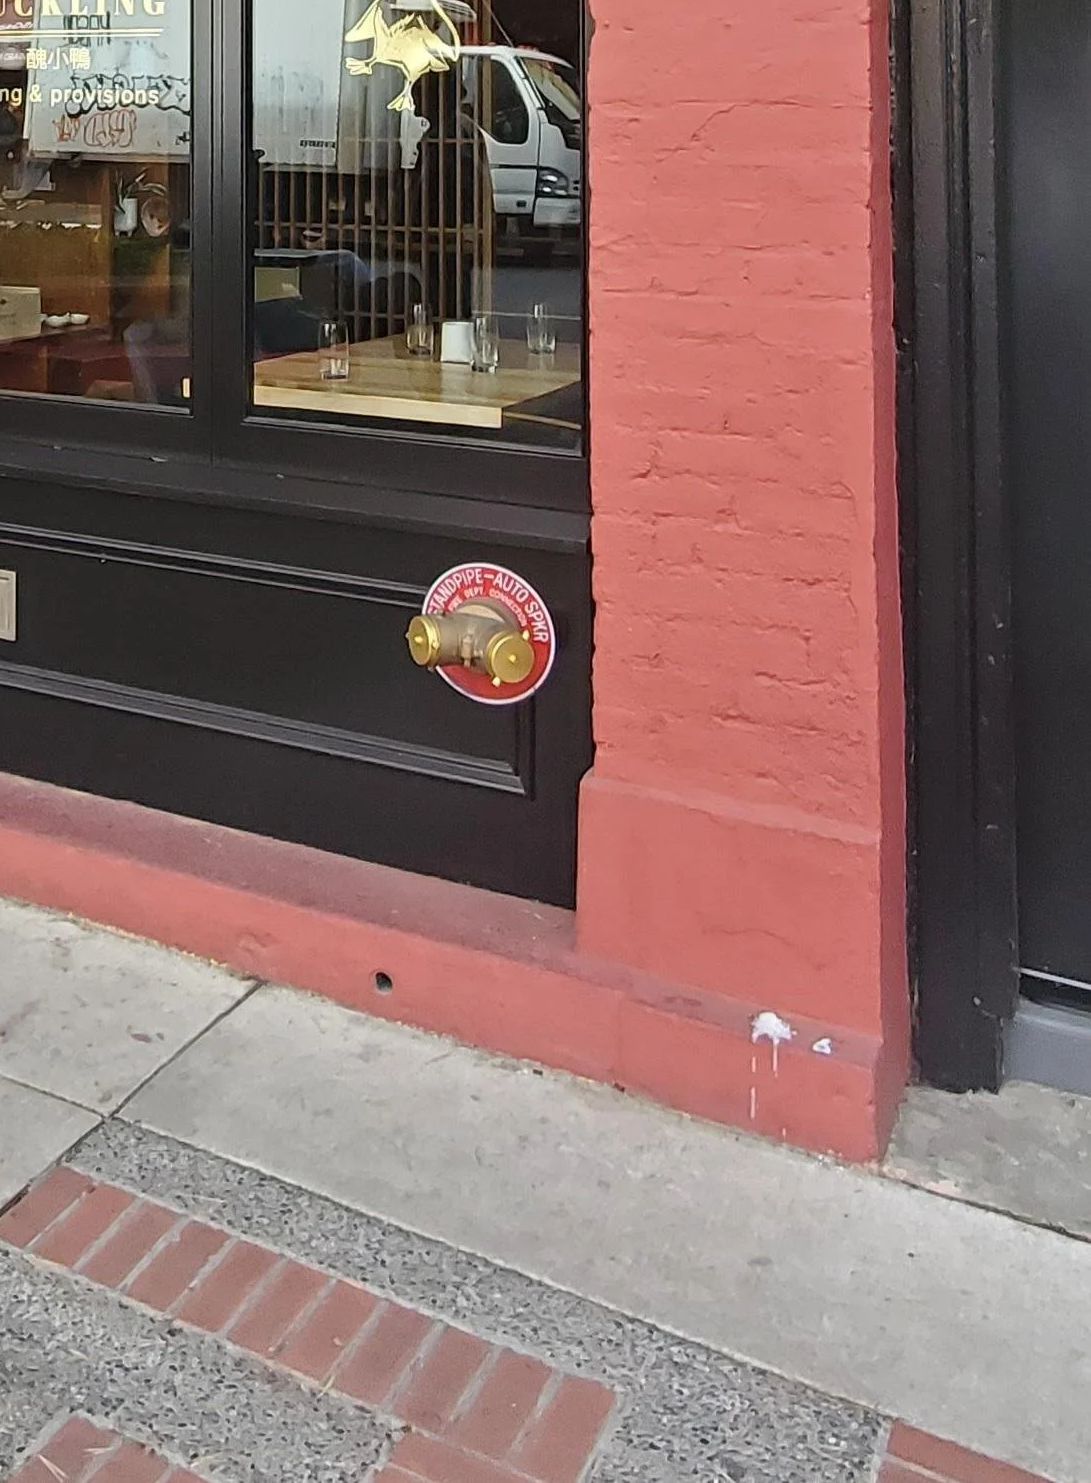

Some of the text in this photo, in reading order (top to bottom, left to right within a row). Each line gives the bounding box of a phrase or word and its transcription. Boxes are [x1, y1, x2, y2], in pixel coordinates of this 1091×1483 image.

[29, 84, 42, 102] &
[50, 85, 160, 107] provisions
[524, 602, 549, 643] SPKR
